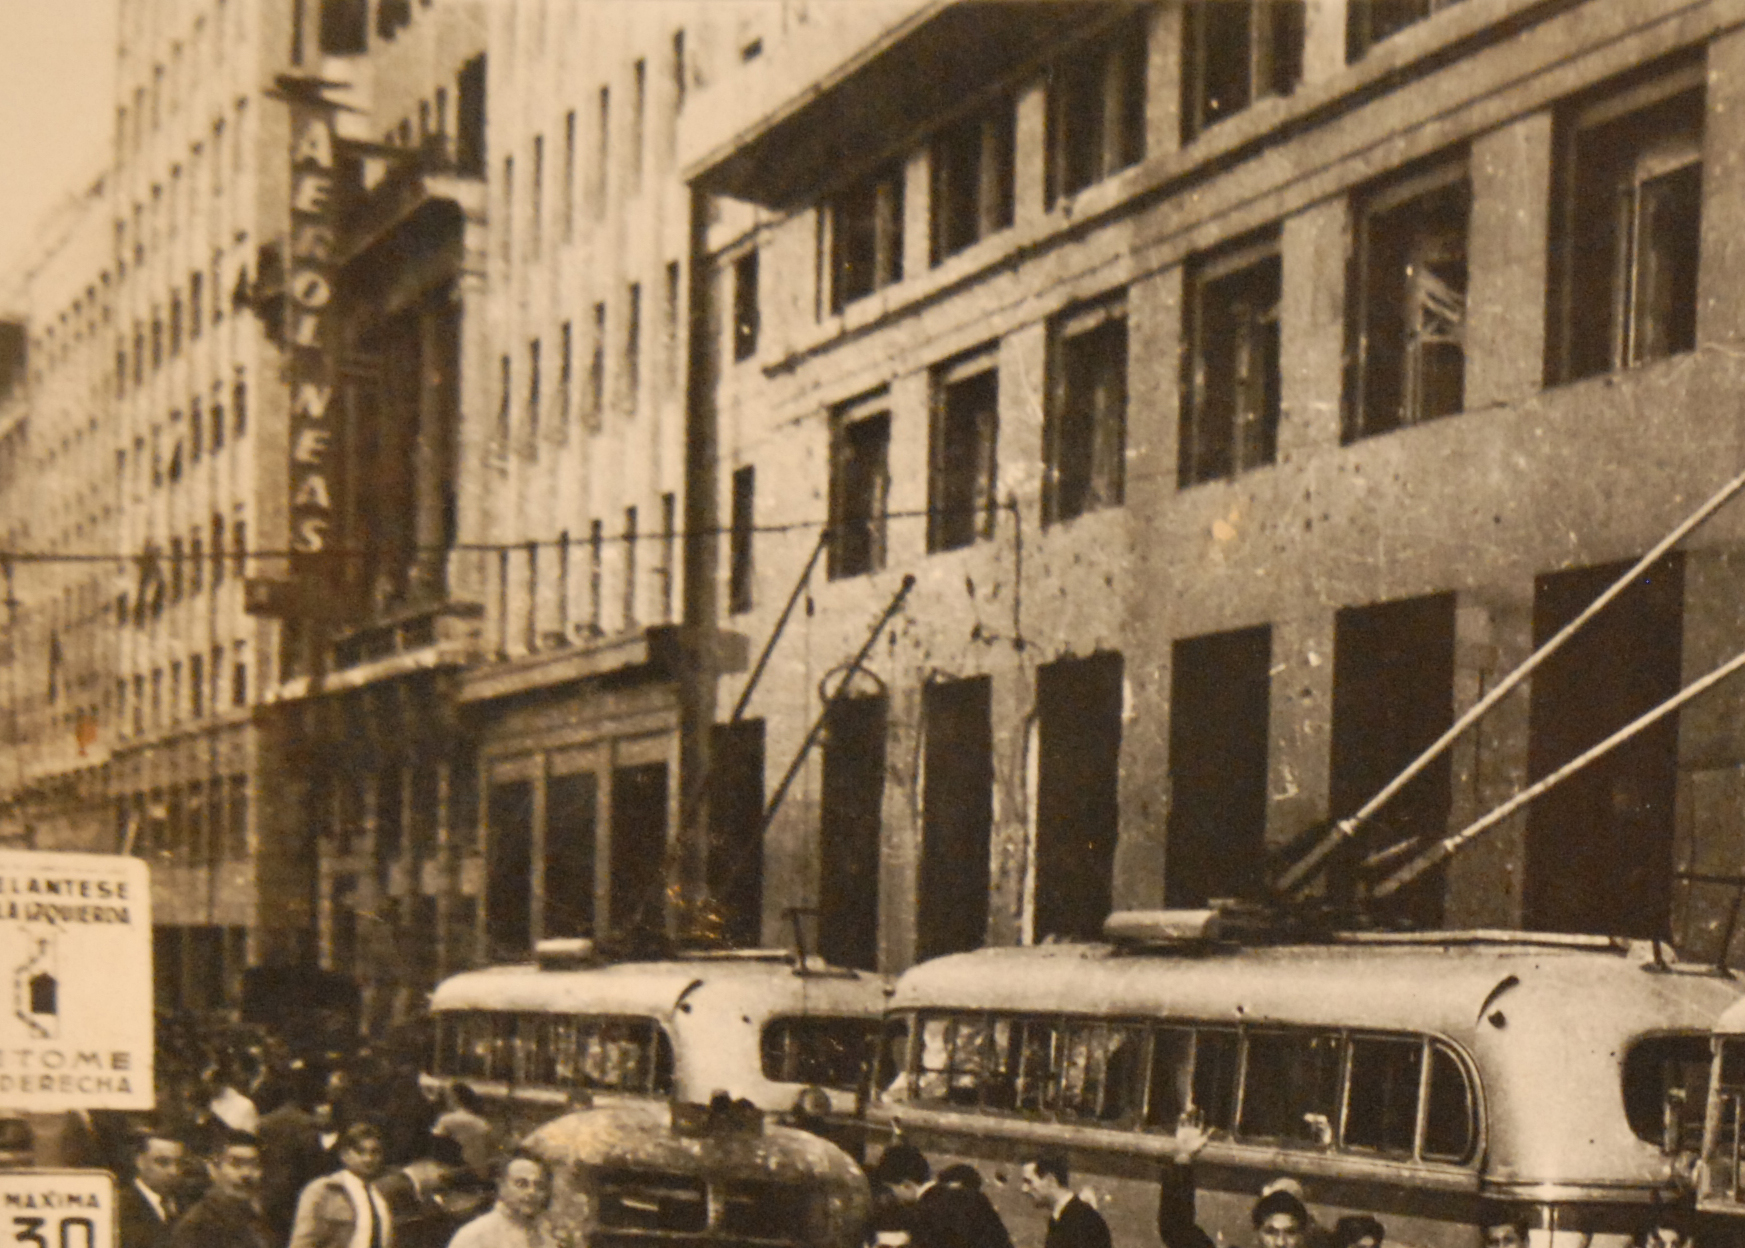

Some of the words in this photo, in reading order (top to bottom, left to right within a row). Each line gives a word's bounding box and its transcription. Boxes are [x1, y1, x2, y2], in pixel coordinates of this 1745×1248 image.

[293, 118, 334, 553] AEROLNEAS
[0, 1073, 133, 1094] DERECHA
[5, 1191, 99, 1209] MAXIMA
